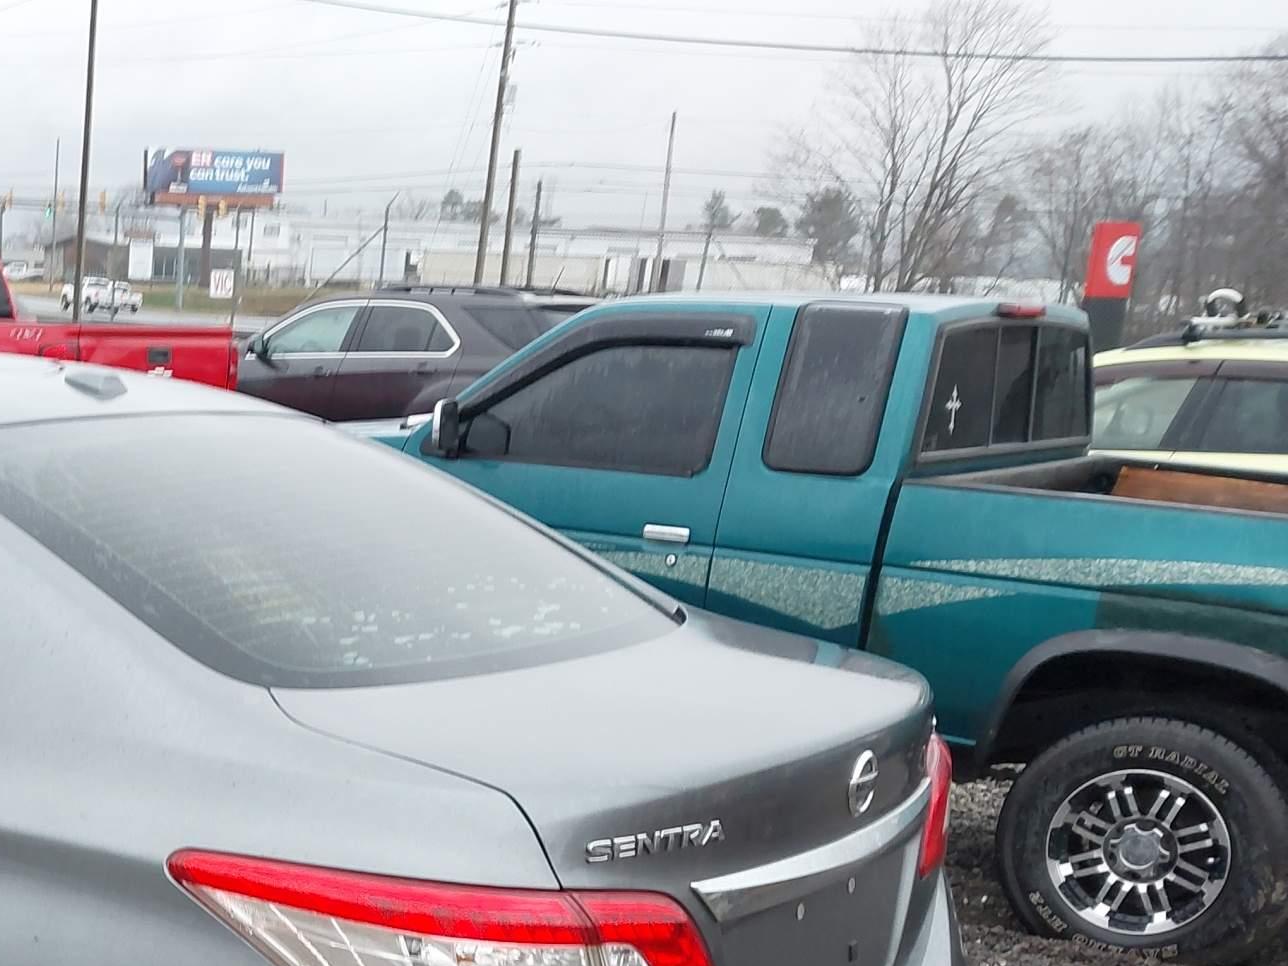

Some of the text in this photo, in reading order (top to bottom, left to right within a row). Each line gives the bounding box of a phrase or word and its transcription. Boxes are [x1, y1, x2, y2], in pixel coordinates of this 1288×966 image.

[190, 168, 213, 181] can
[214, 156, 243, 168] care
[246, 157, 271, 171] you
[1113, 744, 1230, 794] GT RADIAL
[586, 819, 726, 863] SENTRA
